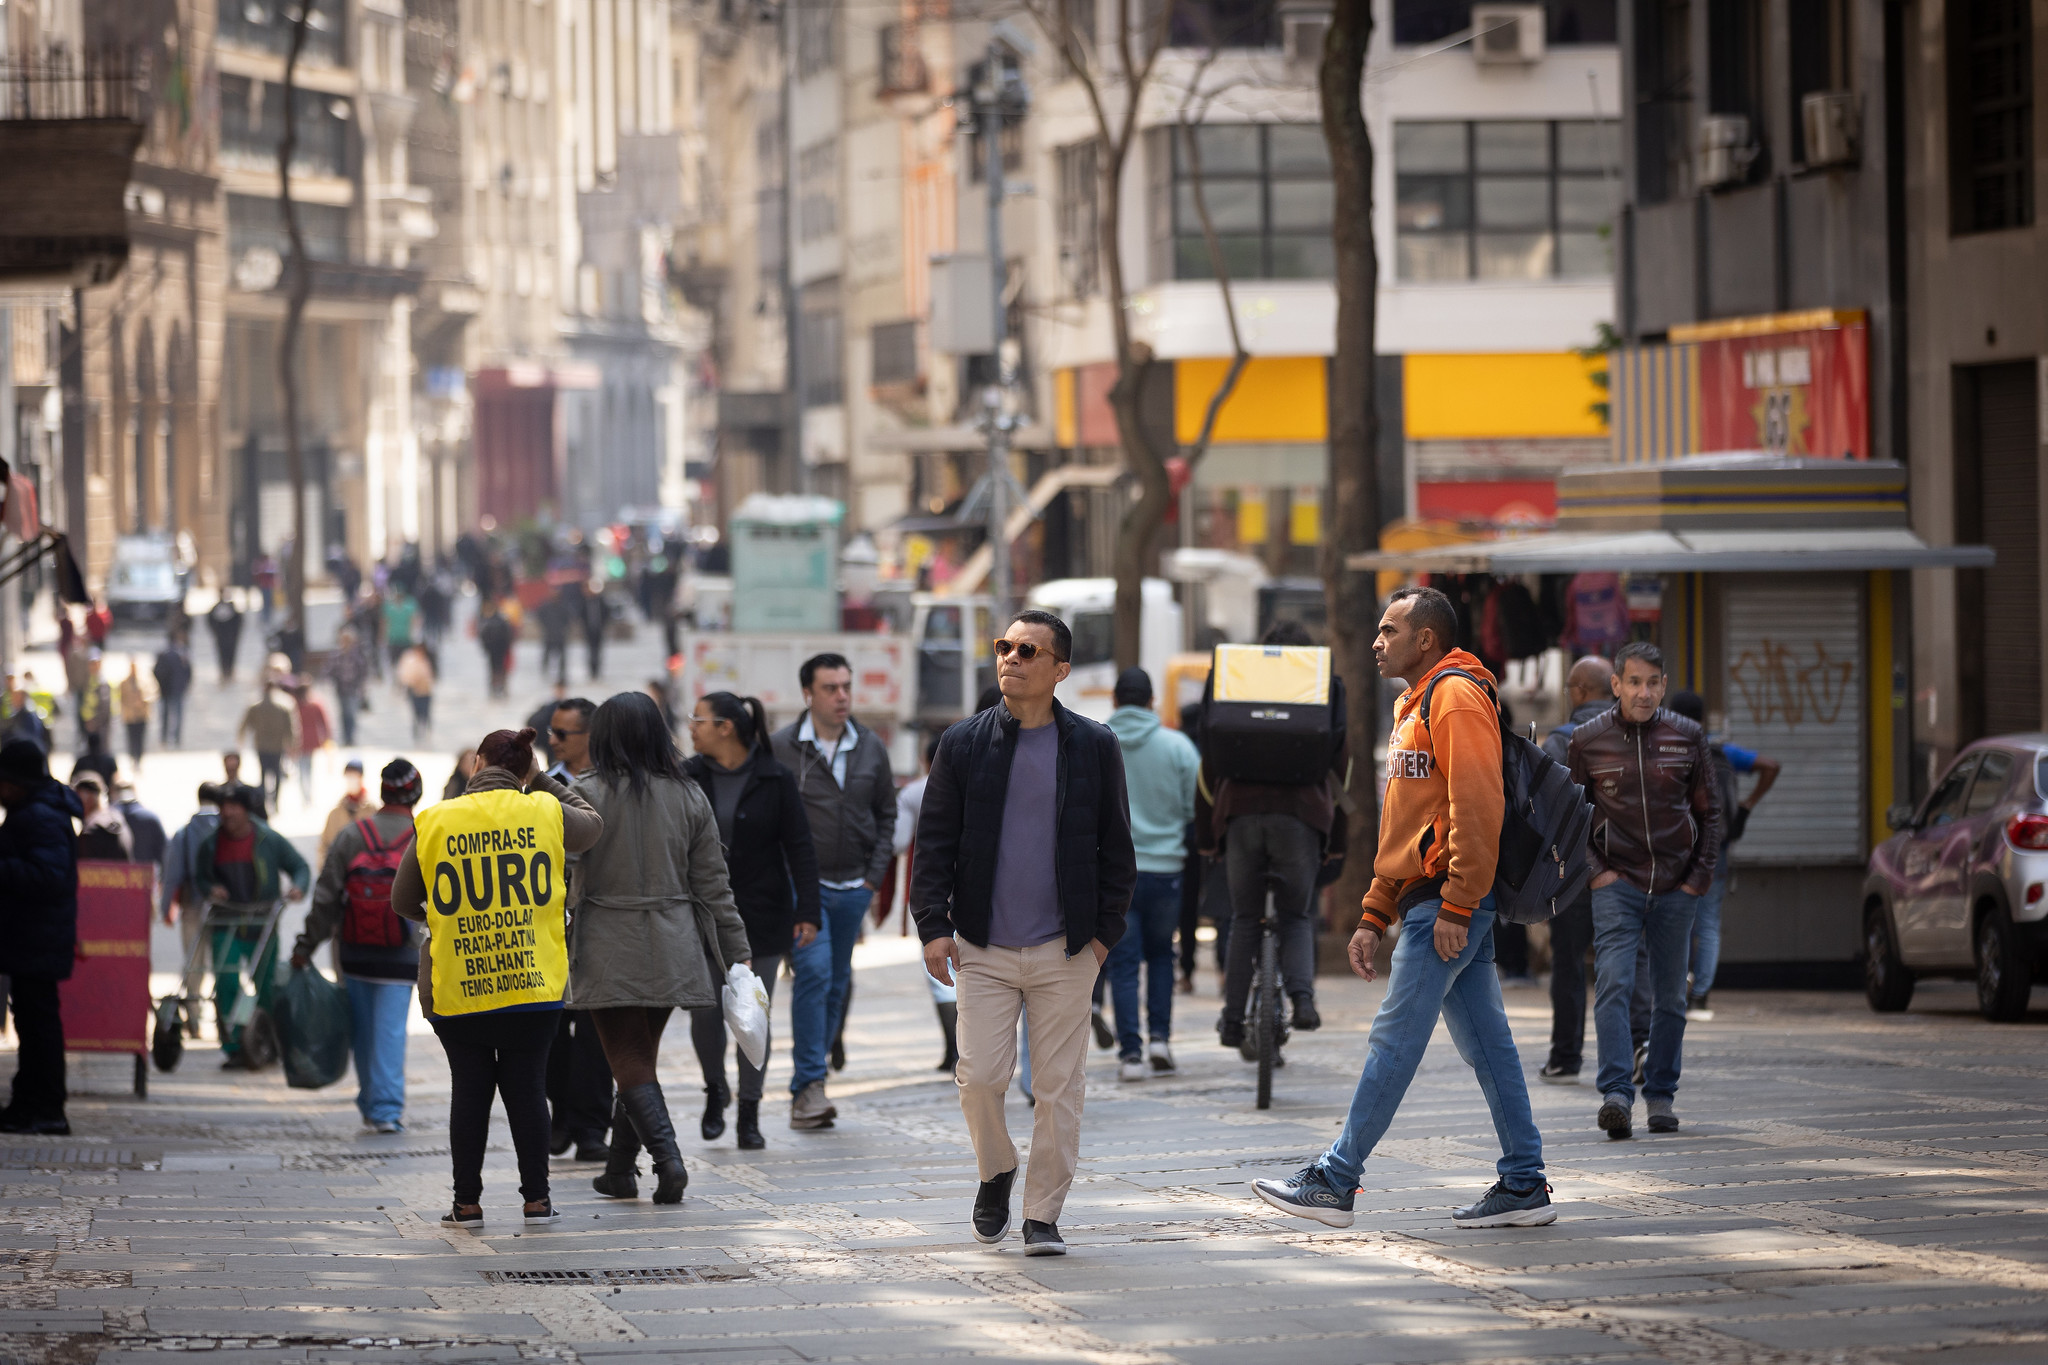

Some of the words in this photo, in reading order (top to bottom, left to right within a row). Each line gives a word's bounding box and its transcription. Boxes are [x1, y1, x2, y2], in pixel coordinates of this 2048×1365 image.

[446, 827, 536, 857] COMPRA-SE
[432, 851, 552, 916] OURO
[453, 929, 536, 957] PRATA-PLATINA
[465, 951, 535, 976] BRILHANTE
[460, 978, 494, 998] TEMOS
[496, 971, 545, 994] ADVOGADOS
